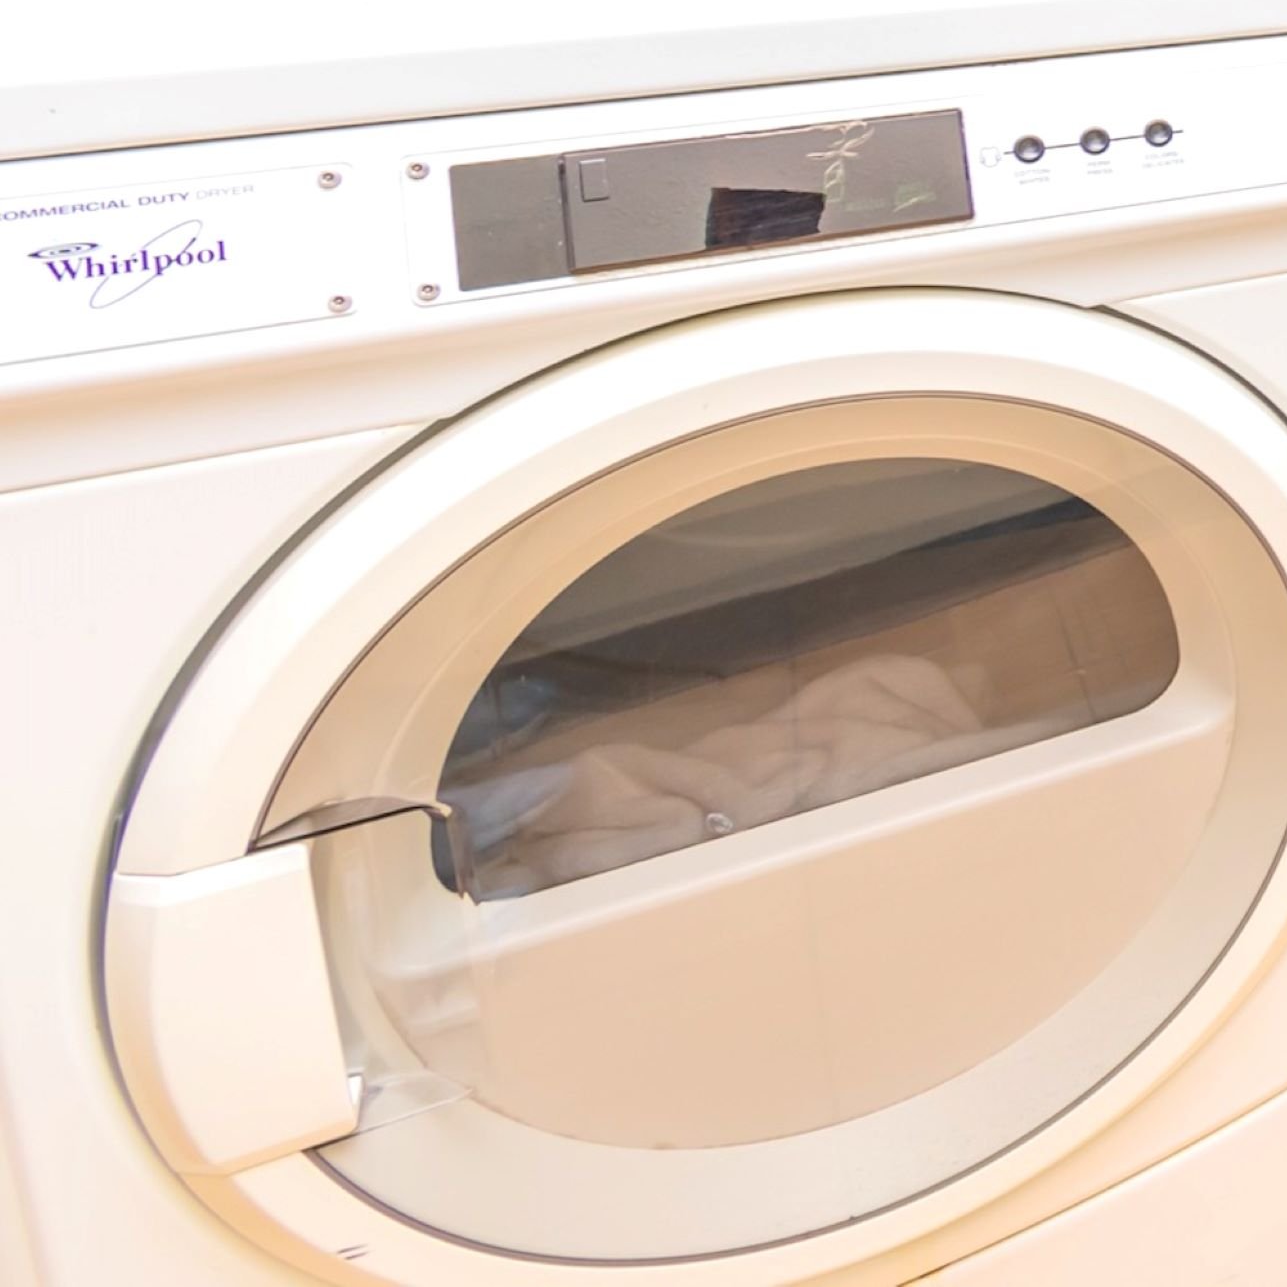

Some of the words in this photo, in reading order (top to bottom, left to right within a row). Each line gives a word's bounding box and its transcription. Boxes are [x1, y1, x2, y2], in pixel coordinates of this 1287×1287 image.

[0, 199, 130, 221] OMMERCIAL
[138, 192, 189, 207] DUTY
[196, 184, 255, 200] DRYER
[45, 239, 228, 282] Whirlpool
